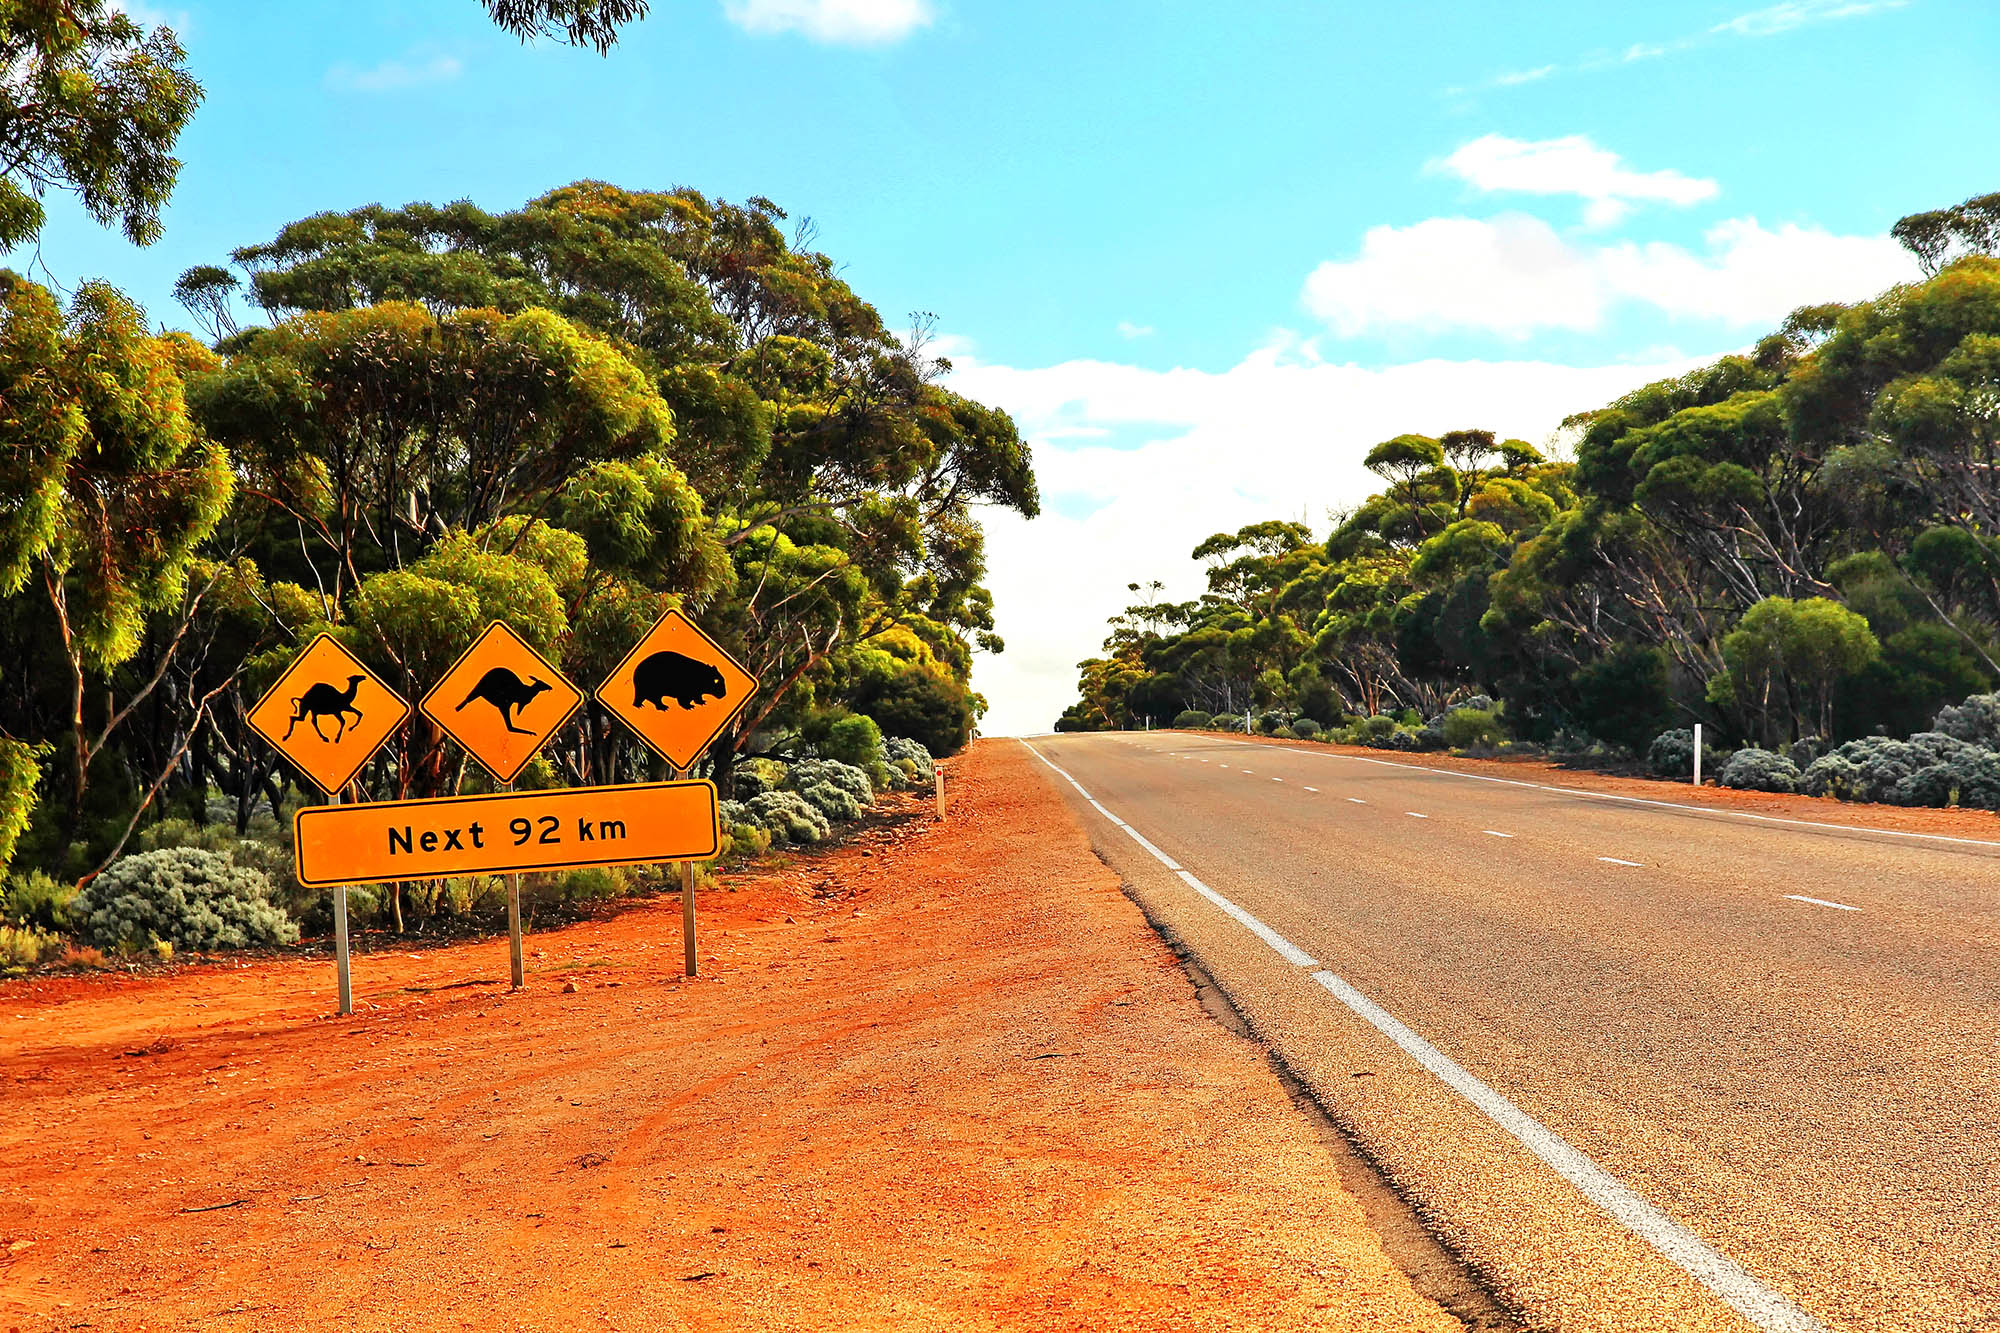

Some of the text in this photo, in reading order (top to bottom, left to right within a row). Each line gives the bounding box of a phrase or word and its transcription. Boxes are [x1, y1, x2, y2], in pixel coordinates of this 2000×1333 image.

[388, 815, 626, 855] Next 92 km
